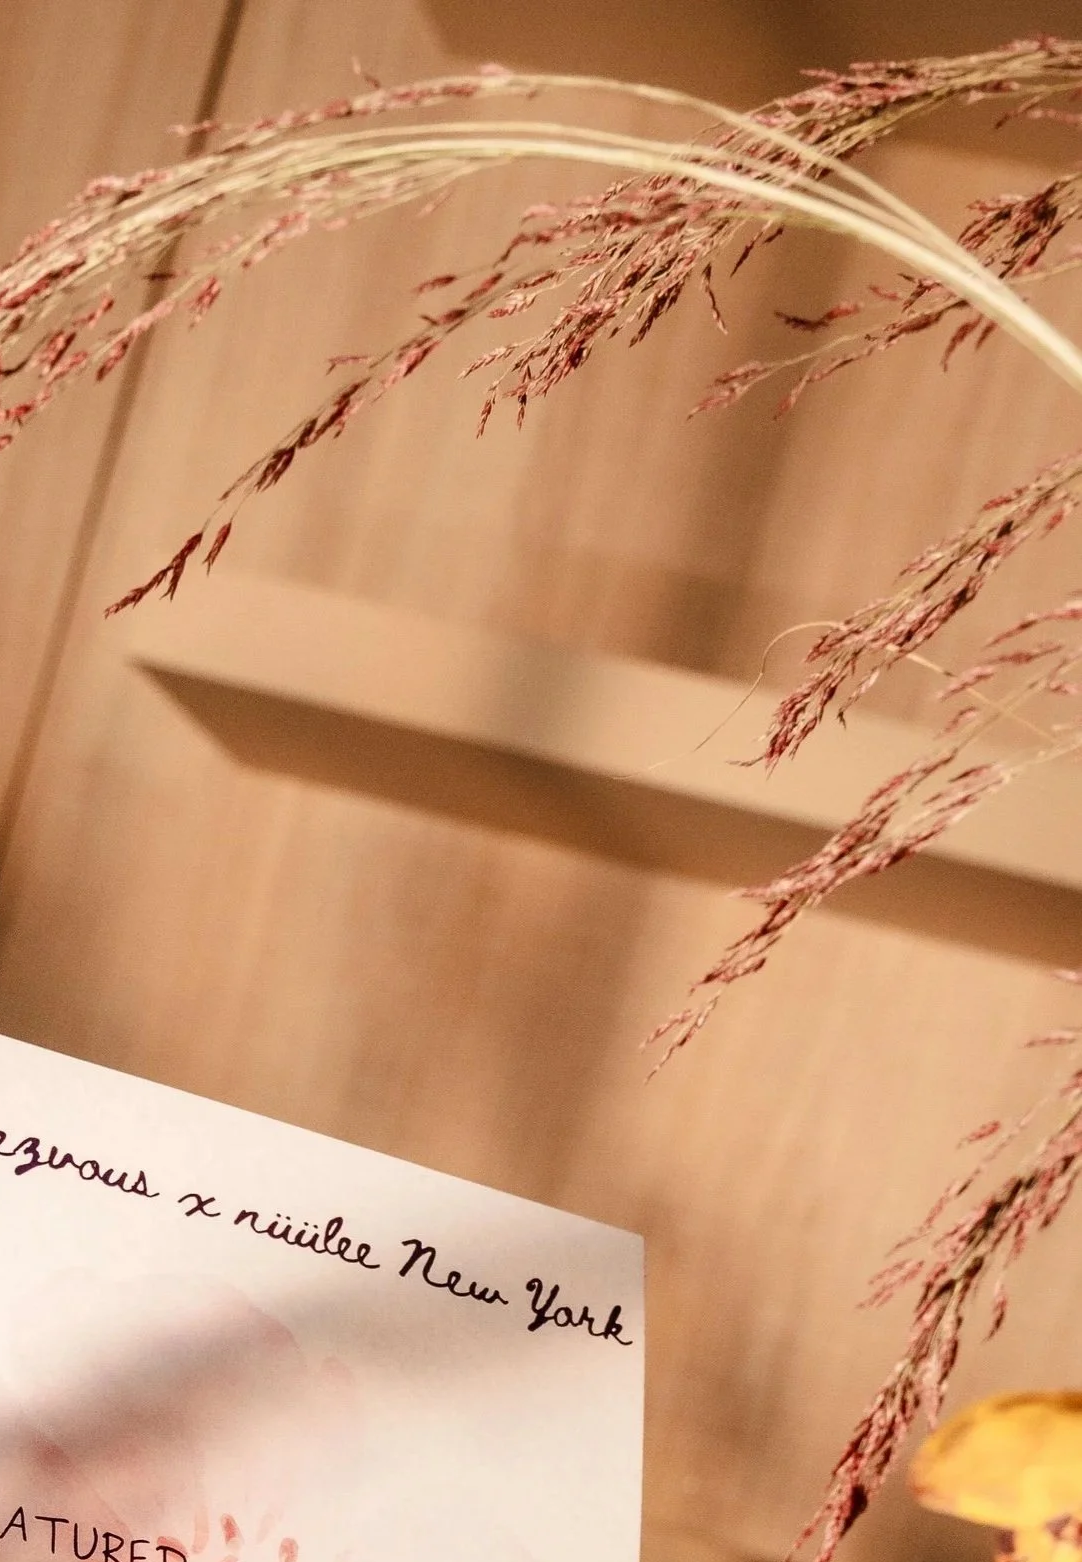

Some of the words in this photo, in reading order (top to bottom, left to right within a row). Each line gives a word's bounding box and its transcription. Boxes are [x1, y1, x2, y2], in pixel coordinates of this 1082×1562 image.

[177, 1192, 221, 1218] x
[233, 1208, 381, 1270] nüülee
[399, 1238, 508, 1306] New
[526, 1277, 635, 1347] York
